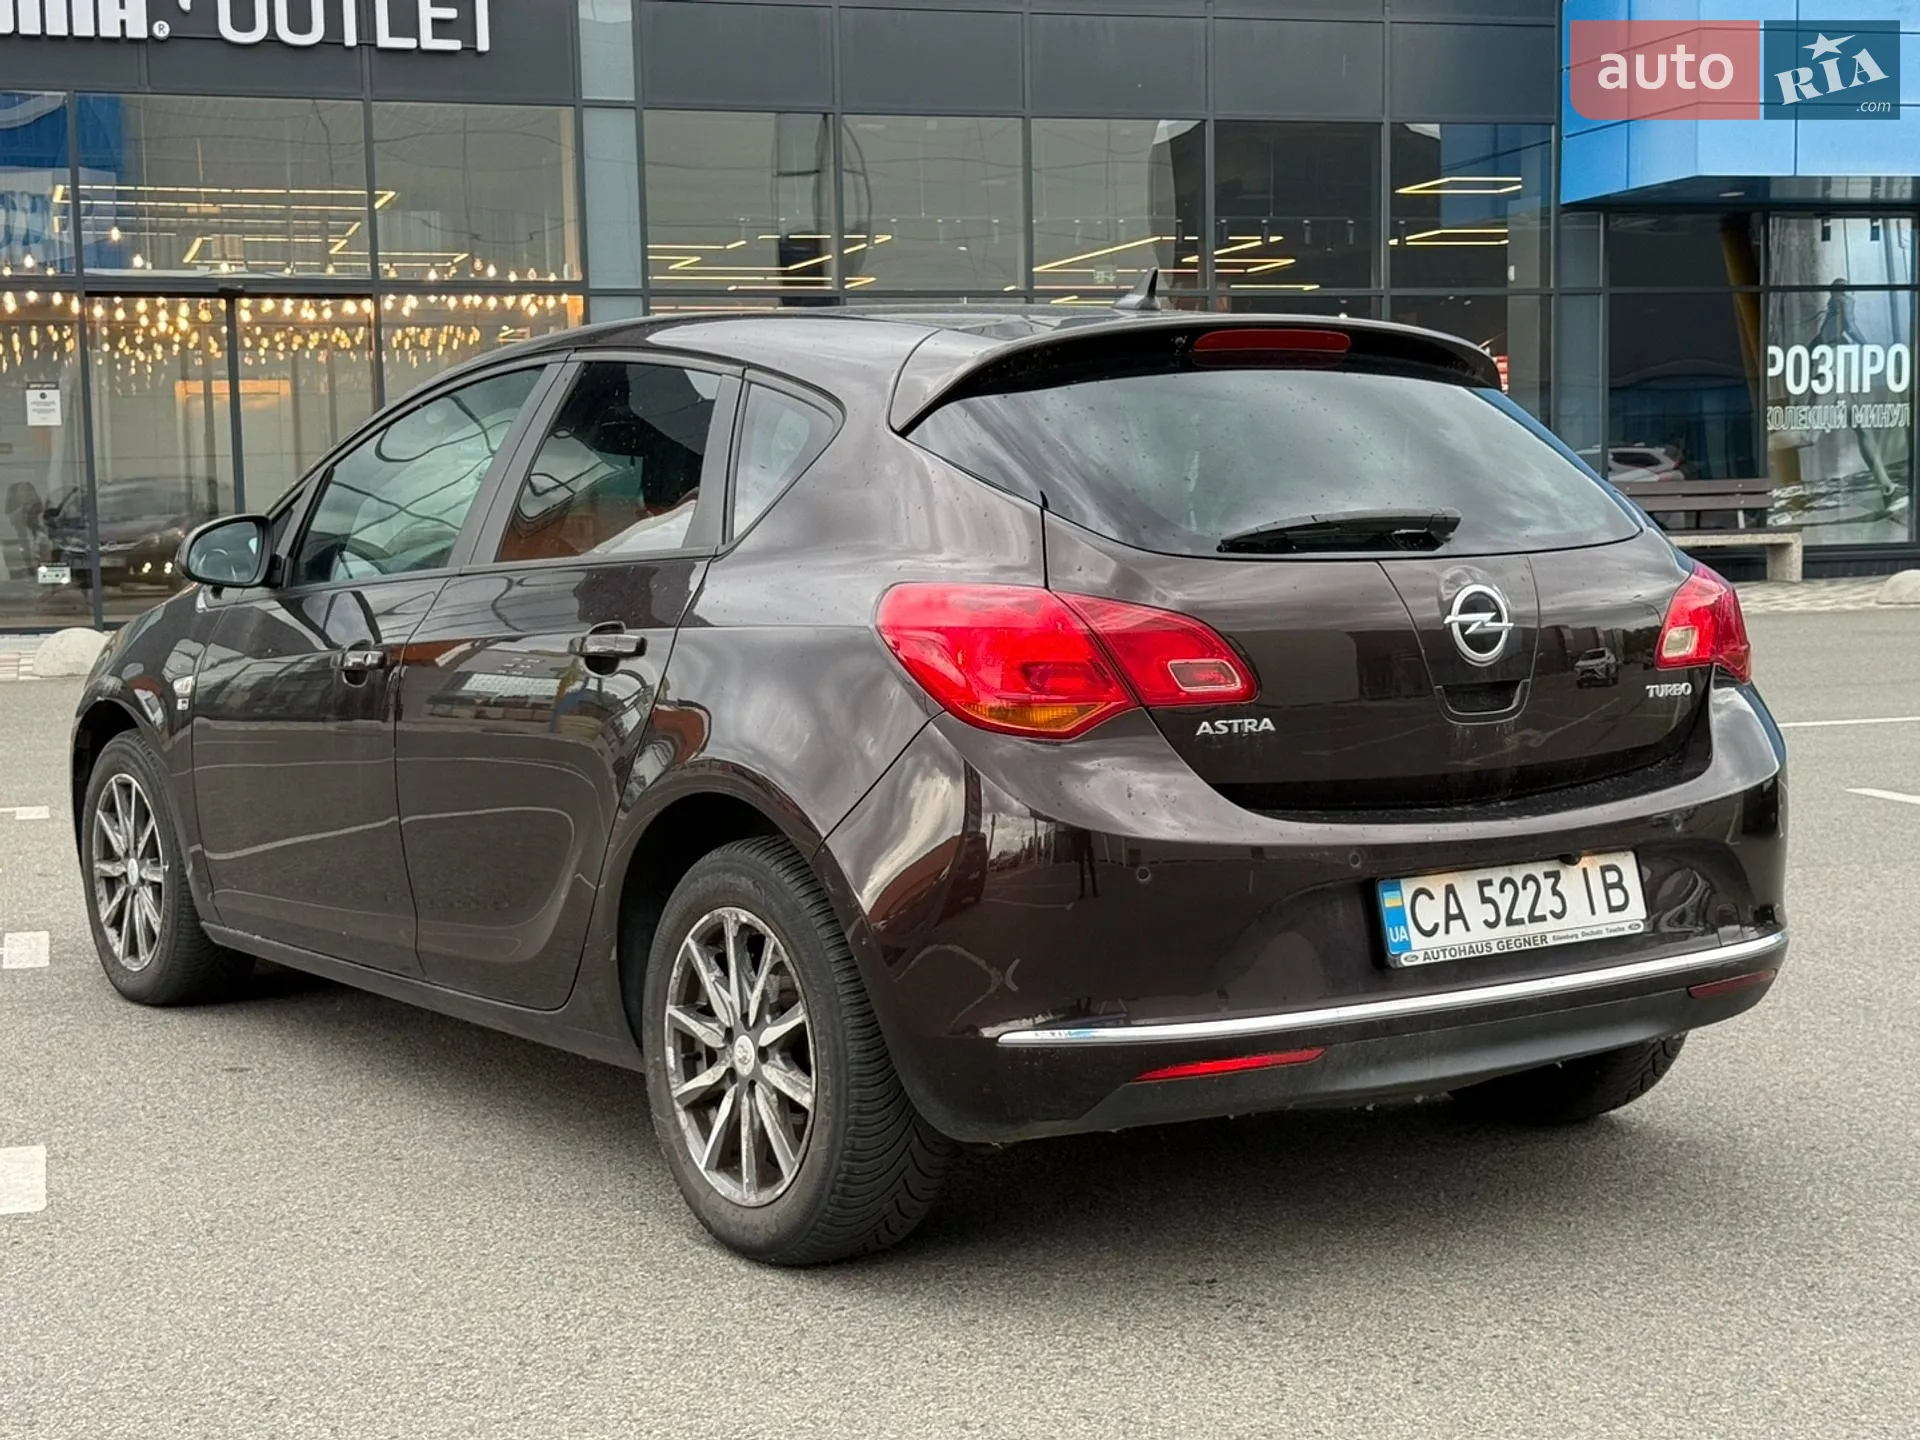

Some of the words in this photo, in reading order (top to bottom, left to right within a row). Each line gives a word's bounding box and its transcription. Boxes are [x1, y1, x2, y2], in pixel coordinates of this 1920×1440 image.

[1645, 682, 1692, 698] TURBO
[1195, 717, 1276, 736] ASTRA
[1410, 883, 1471, 937] CA
[1477, 869, 1567, 929] 5223
[1582, 863, 1631, 916] IB
[1390, 925, 1409, 943] UA
[1422, 941, 1493, 962] AUTOHAUS
[1495, 934, 1549, 952] GEGNER
